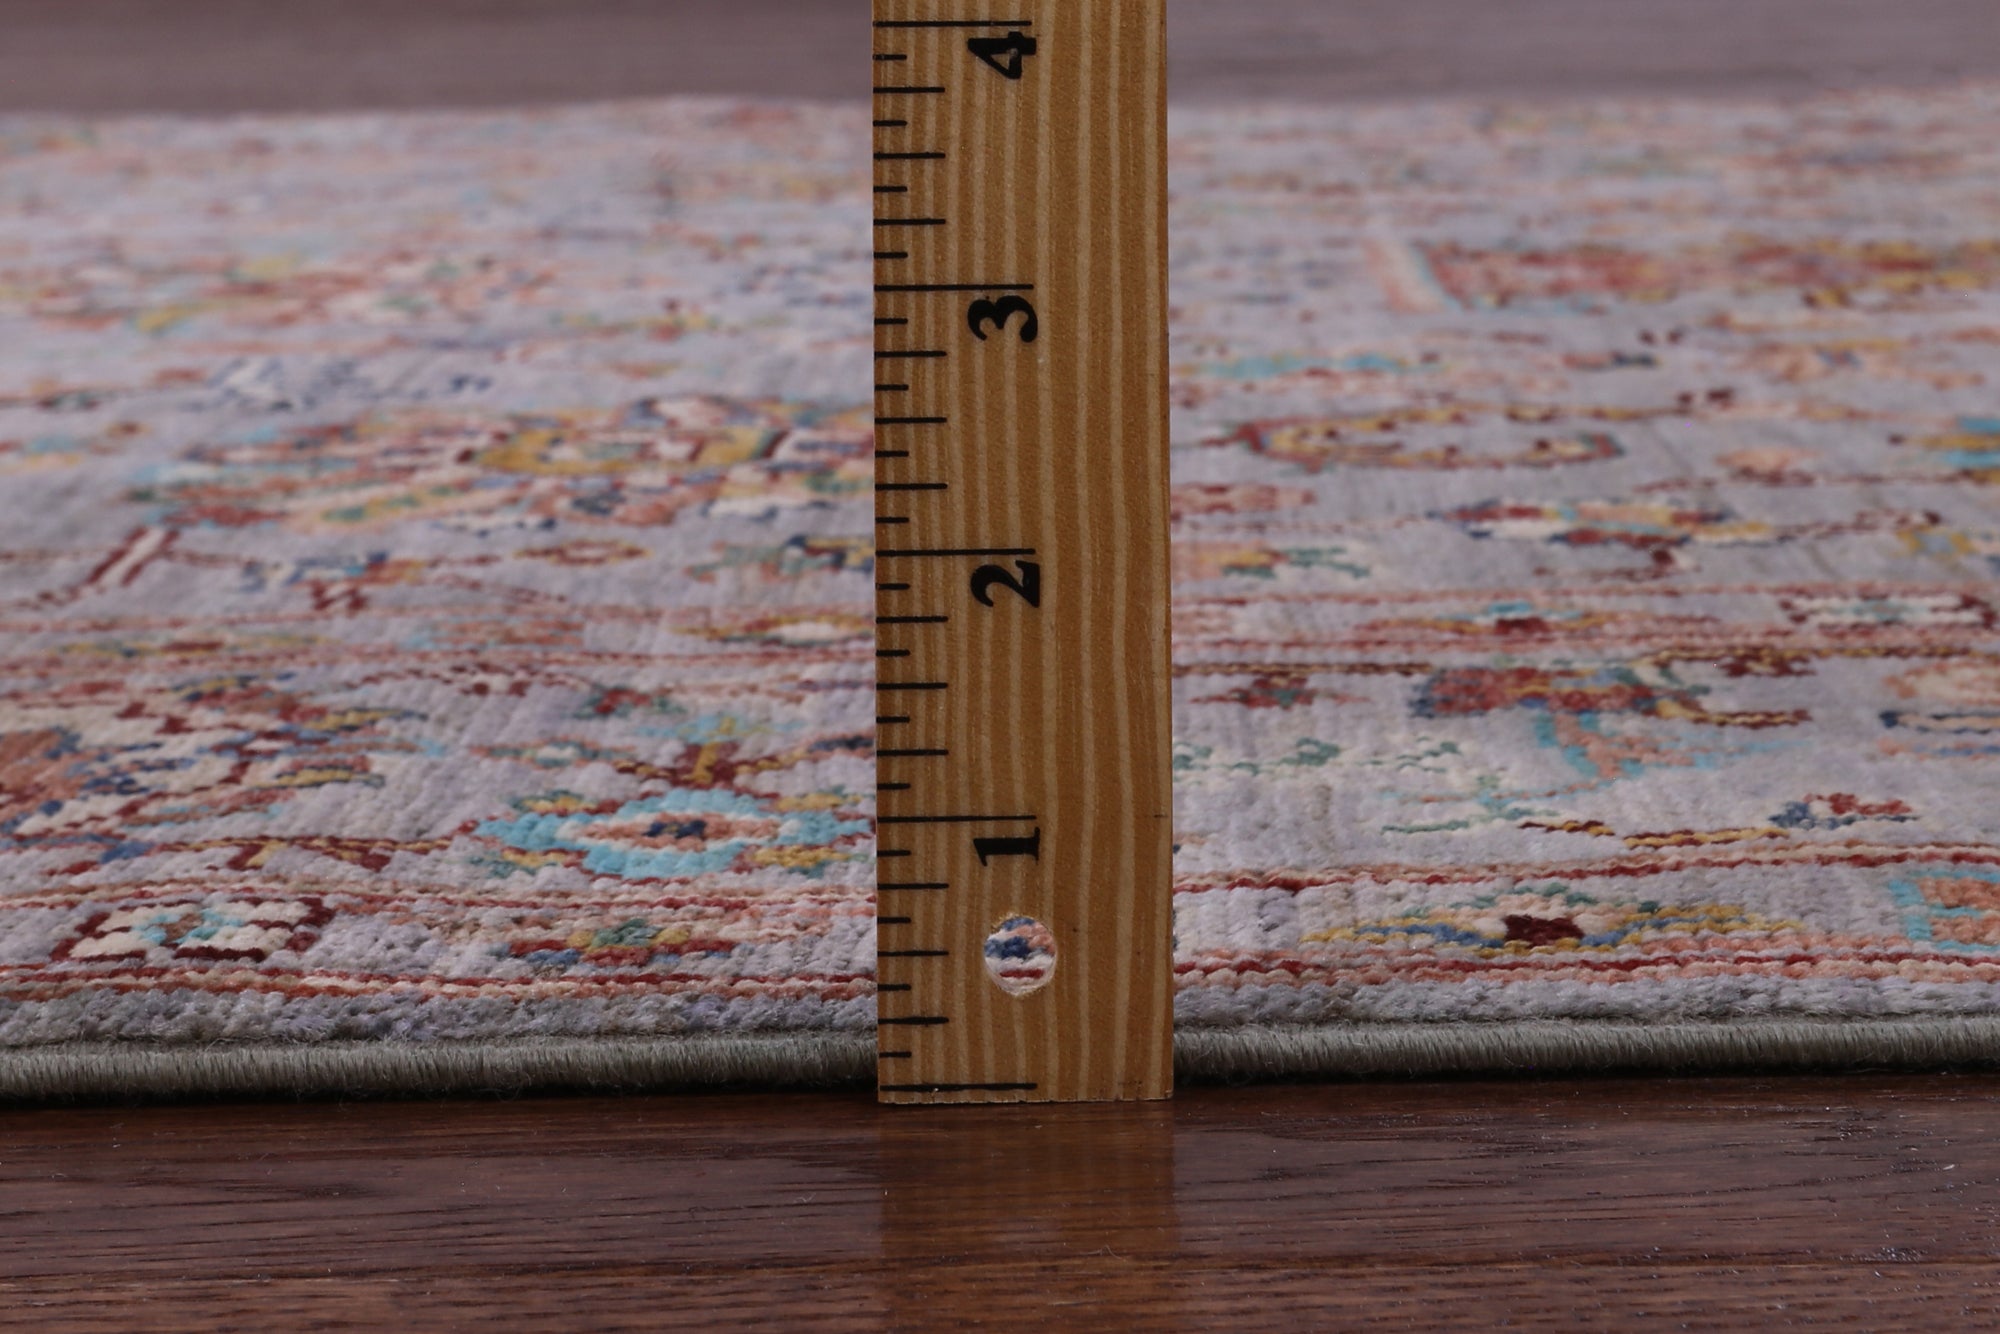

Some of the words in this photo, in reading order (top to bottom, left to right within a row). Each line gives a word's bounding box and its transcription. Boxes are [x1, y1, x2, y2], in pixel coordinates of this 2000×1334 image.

[967, 31, 1037, 80] 4
[967, 295, 1039, 343] 3
[970, 559, 1041, 608] 2
[973, 827, 1041, 867] 1
